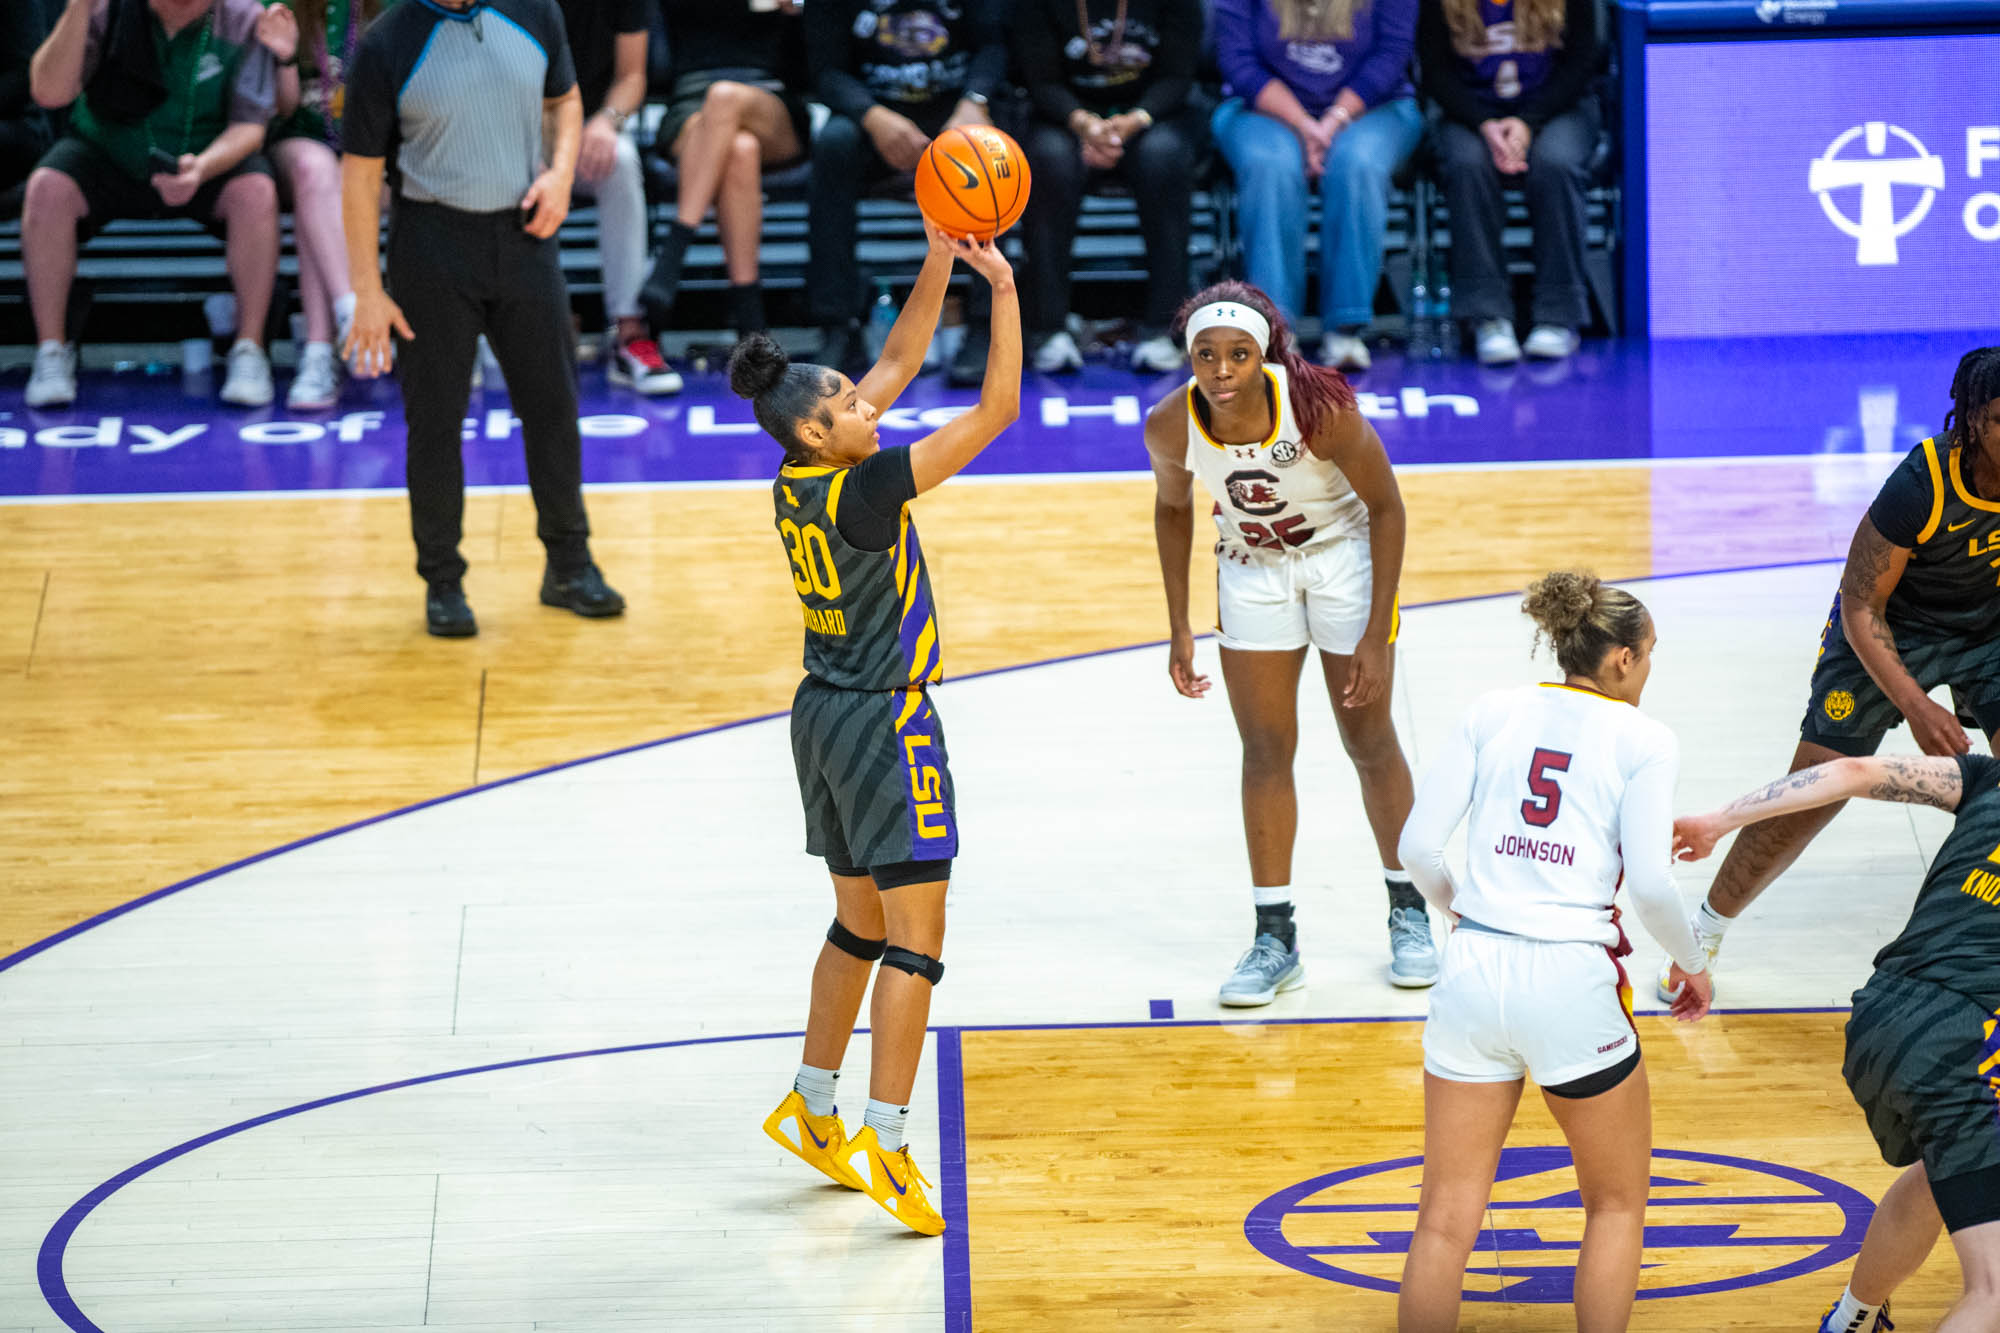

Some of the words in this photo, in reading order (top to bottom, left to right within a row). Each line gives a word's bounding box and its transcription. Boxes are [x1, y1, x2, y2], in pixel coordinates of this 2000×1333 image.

[239, 411, 385, 444] of
[779, 518, 842, 601] 30
[905, 735, 947, 839] LSU
[1520, 747, 1573, 829] 5
[1495, 834, 1576, 867] JOHNSON
[1960, 868, 2000, 906] KNO
